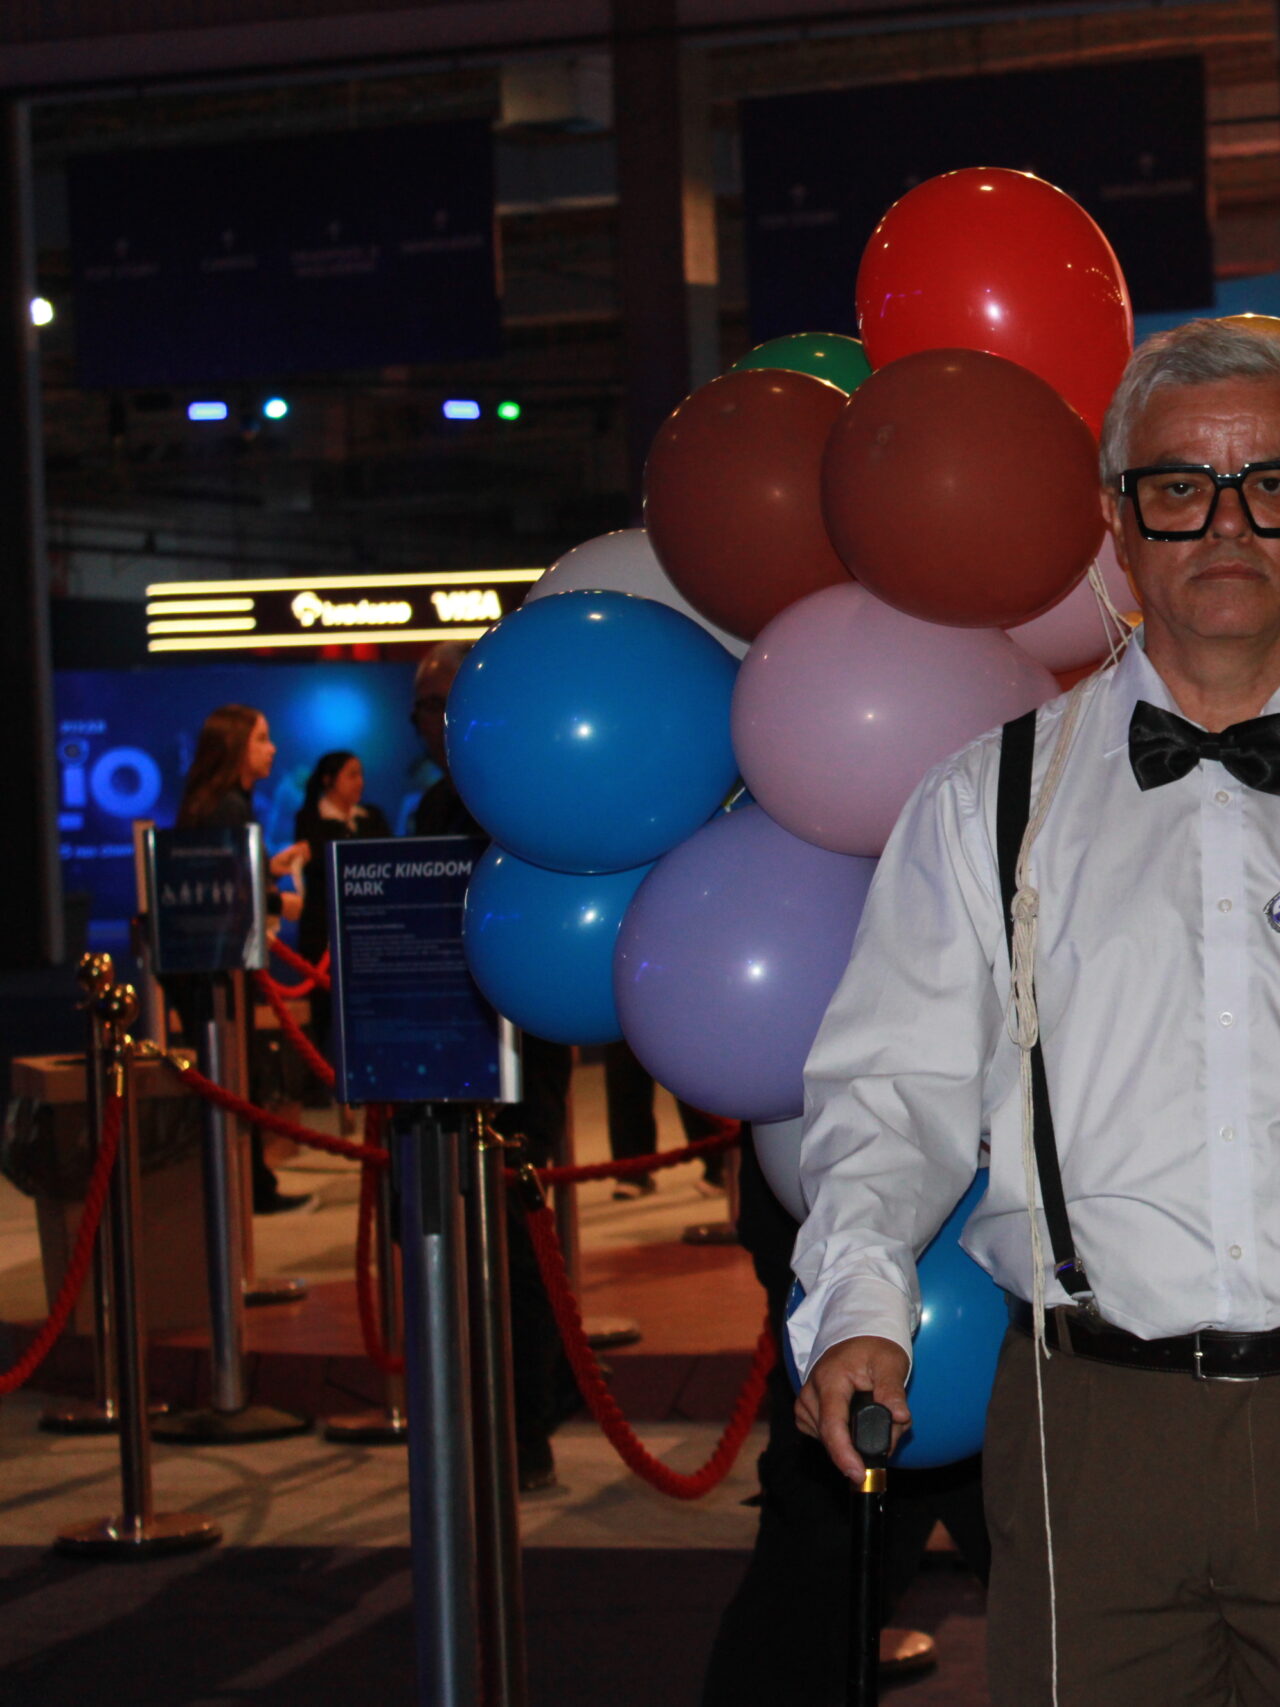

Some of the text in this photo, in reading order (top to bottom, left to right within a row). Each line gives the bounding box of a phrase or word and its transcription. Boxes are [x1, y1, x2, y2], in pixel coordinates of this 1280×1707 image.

[344, 861, 473, 879] MAGIC KINGDOM
[344, 881, 384, 896] PARK
